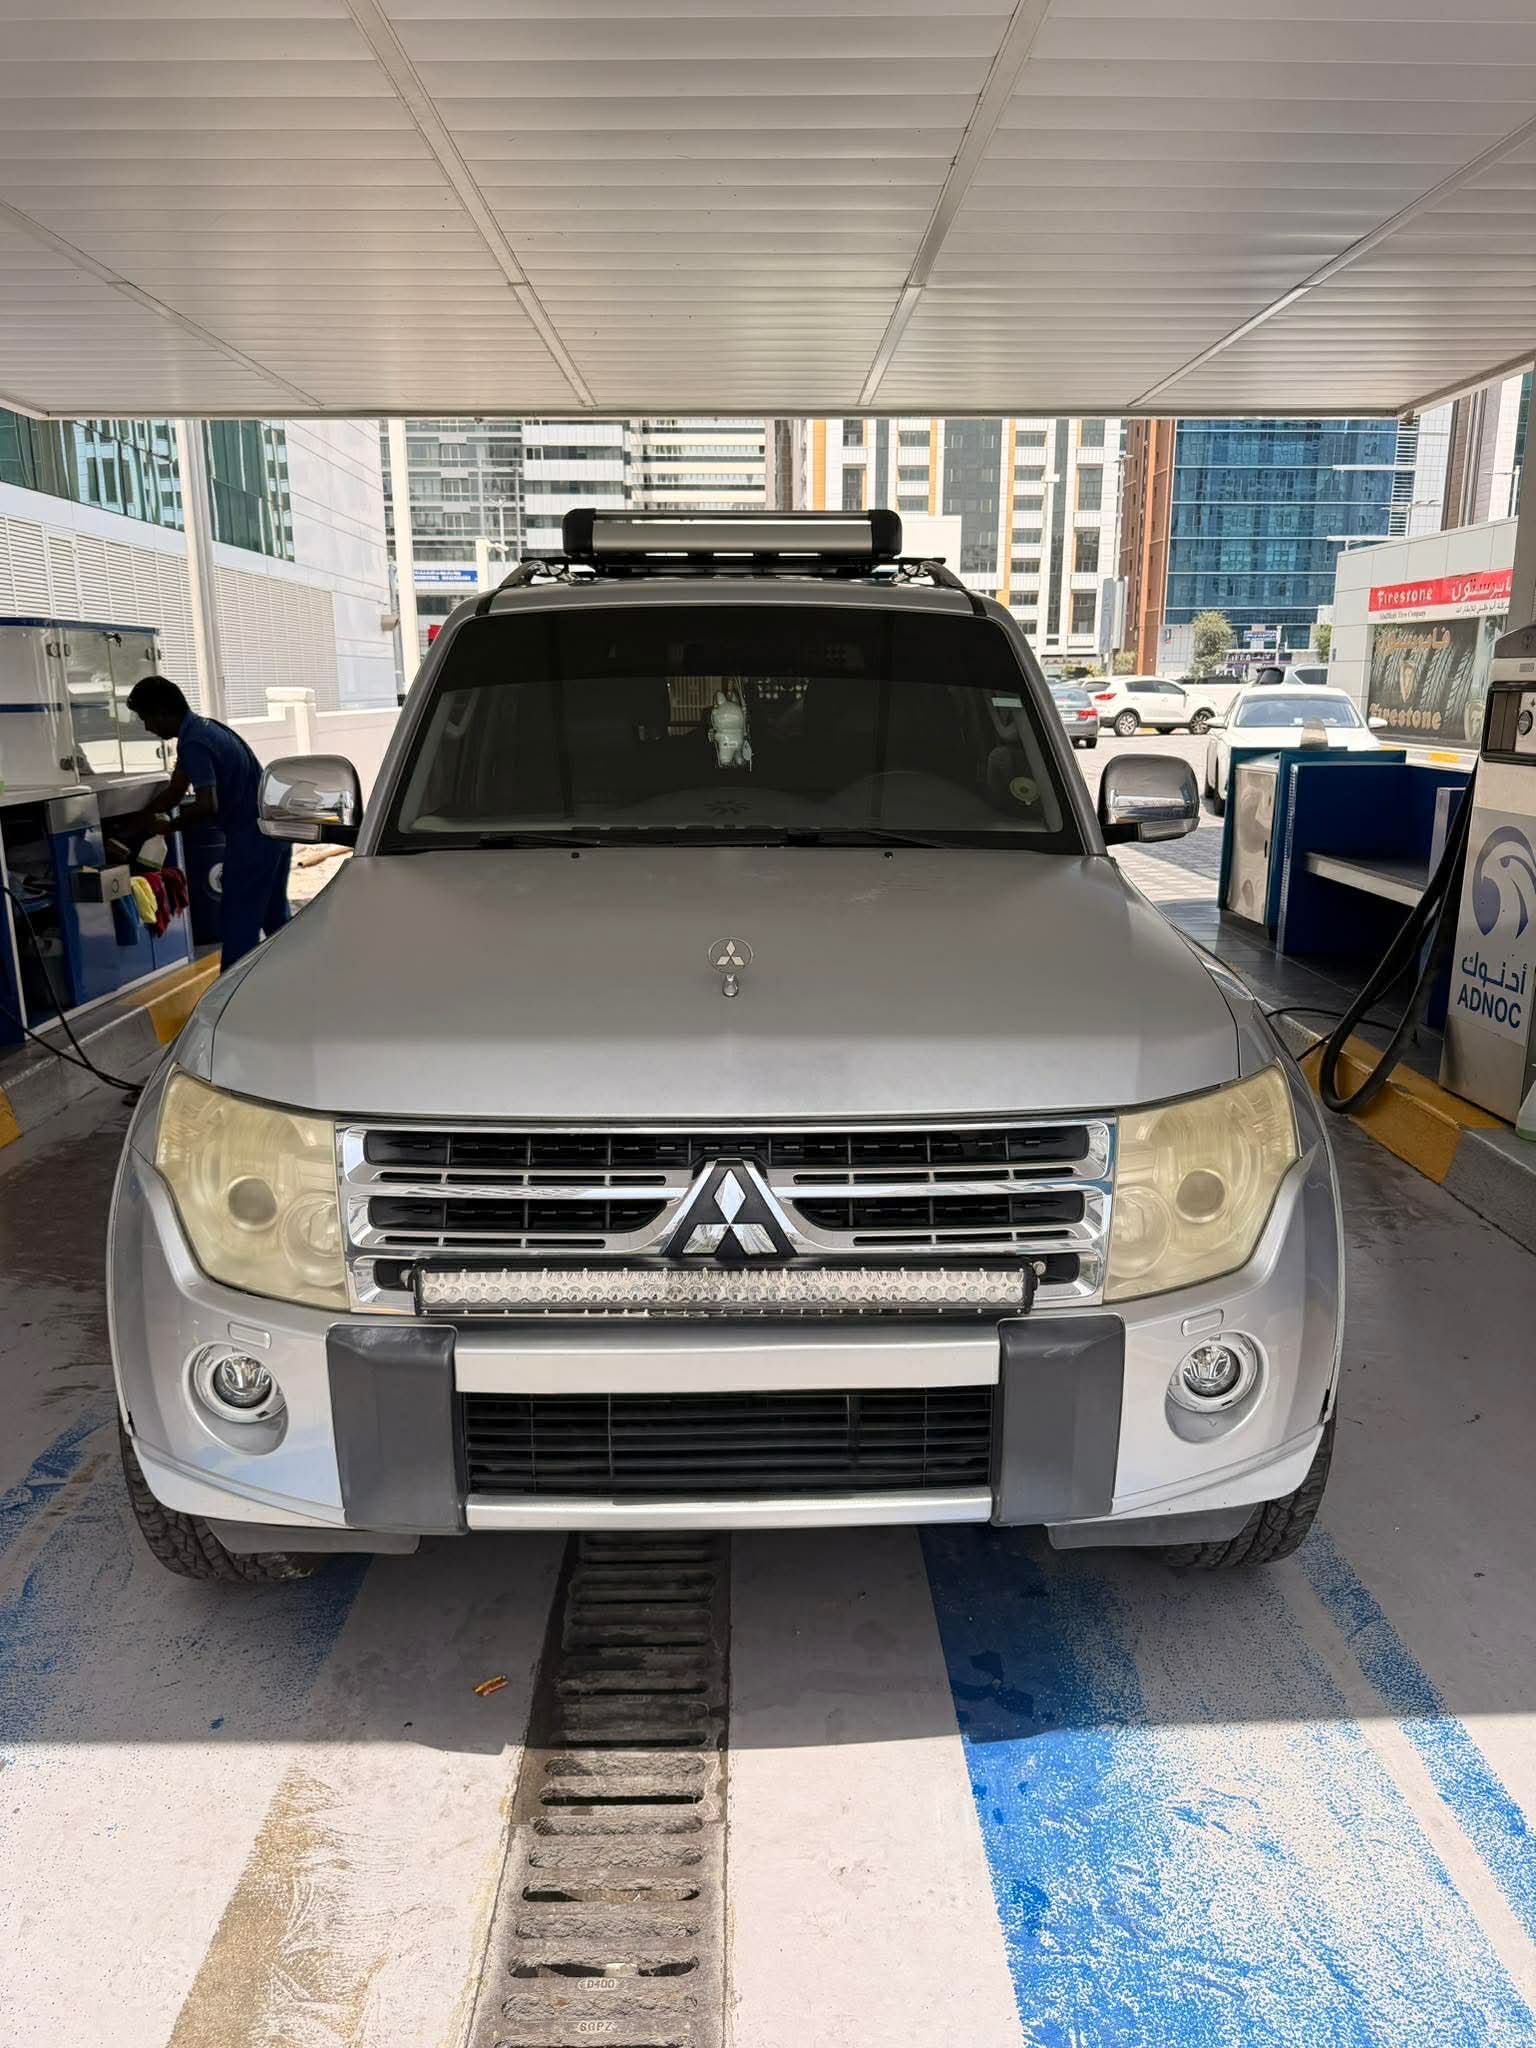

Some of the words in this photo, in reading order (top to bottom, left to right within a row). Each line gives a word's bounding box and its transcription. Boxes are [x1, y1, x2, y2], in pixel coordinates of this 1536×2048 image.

[1377, 586, 1434, 608] Firestone
[1451, 574, 1512, 602] ايرستون
[1456, 983, 1522, 1029] ADNOC
